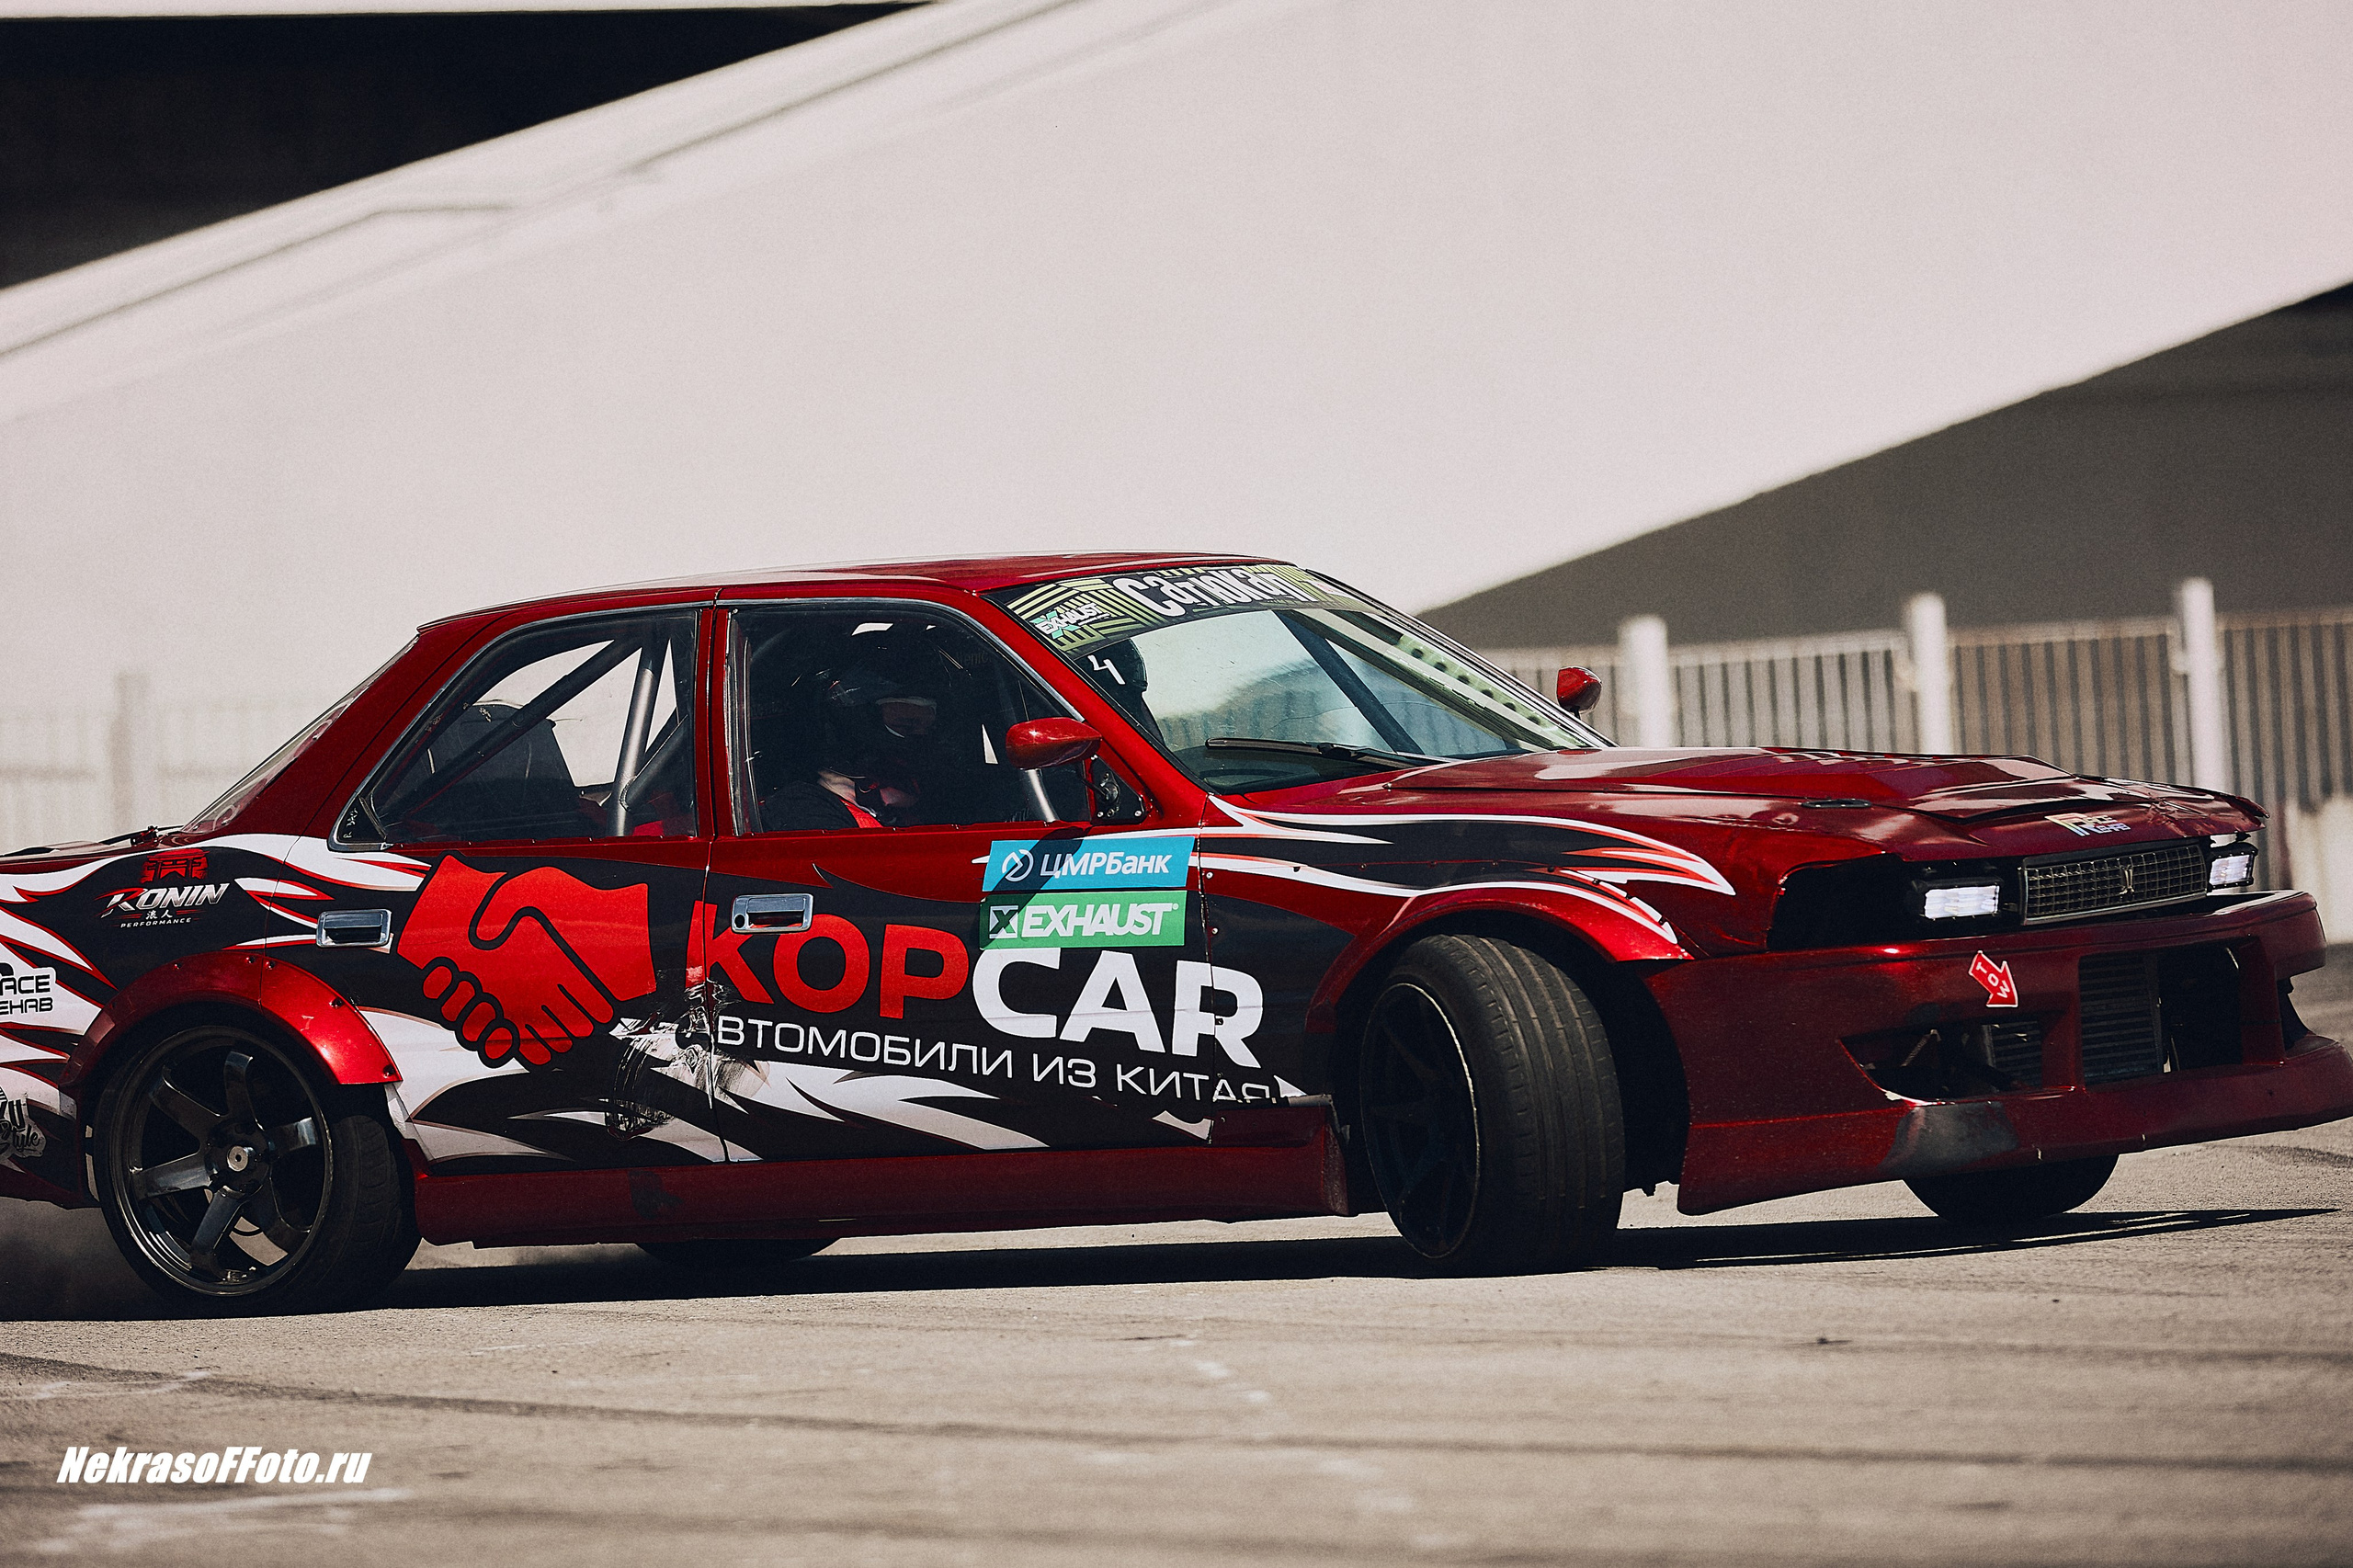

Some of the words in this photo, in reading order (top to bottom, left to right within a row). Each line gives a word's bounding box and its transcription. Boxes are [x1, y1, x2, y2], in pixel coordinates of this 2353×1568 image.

[1035, 602, 1104, 635] EXHAUST
[1040, 851, 1173, 879] ЦМРБанк
[94, 882, 231, 918] RONIN
[120, 917, 192, 928] PERFORMANCE
[1021, 903, 1174, 937] EXHAUST
[1975, 961, 2011, 999] TOW
[691, 1011, 1012, 1080] ВТОМОБИЛИ
[1033, 1053, 1096, 1088] ИЗ
